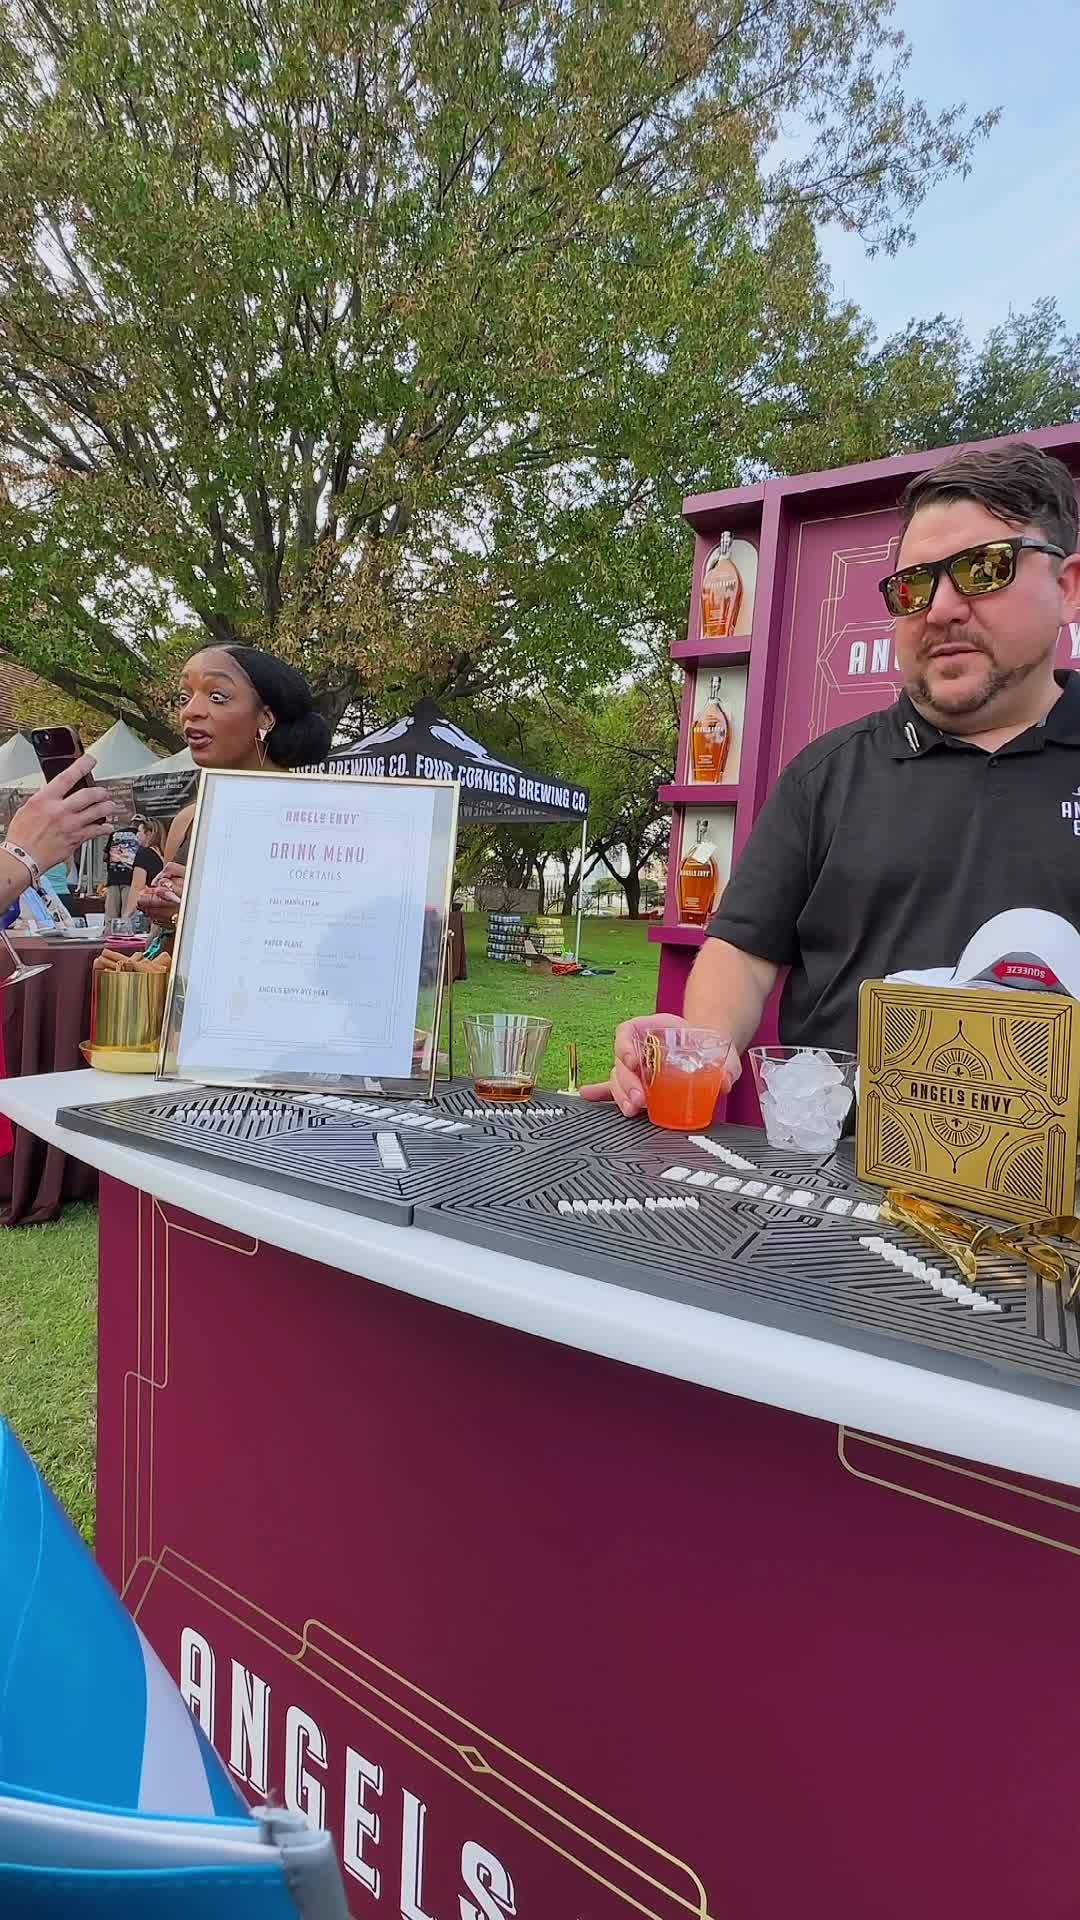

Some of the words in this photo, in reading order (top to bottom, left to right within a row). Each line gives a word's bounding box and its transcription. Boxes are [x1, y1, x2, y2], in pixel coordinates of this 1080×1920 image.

[329, 757, 385, 777] BREWING
[388, 753, 410, 777] CO.
[416, 754, 454, 780] FOUR
[457, 766, 516, 796] CORNERS
[519, 778, 570, 808] BREWING
[572, 789, 588, 813] CO.
[270, 842, 317, 860] DRINK
[323, 845, 365, 863] MENU
[289, 868, 343, 881] COCKTAILS
[1007, 965, 1046, 979] SQUEEZE
[910, 1082, 965, 1106] ANGELS
[970, 1092, 1012, 1115] ENVY
